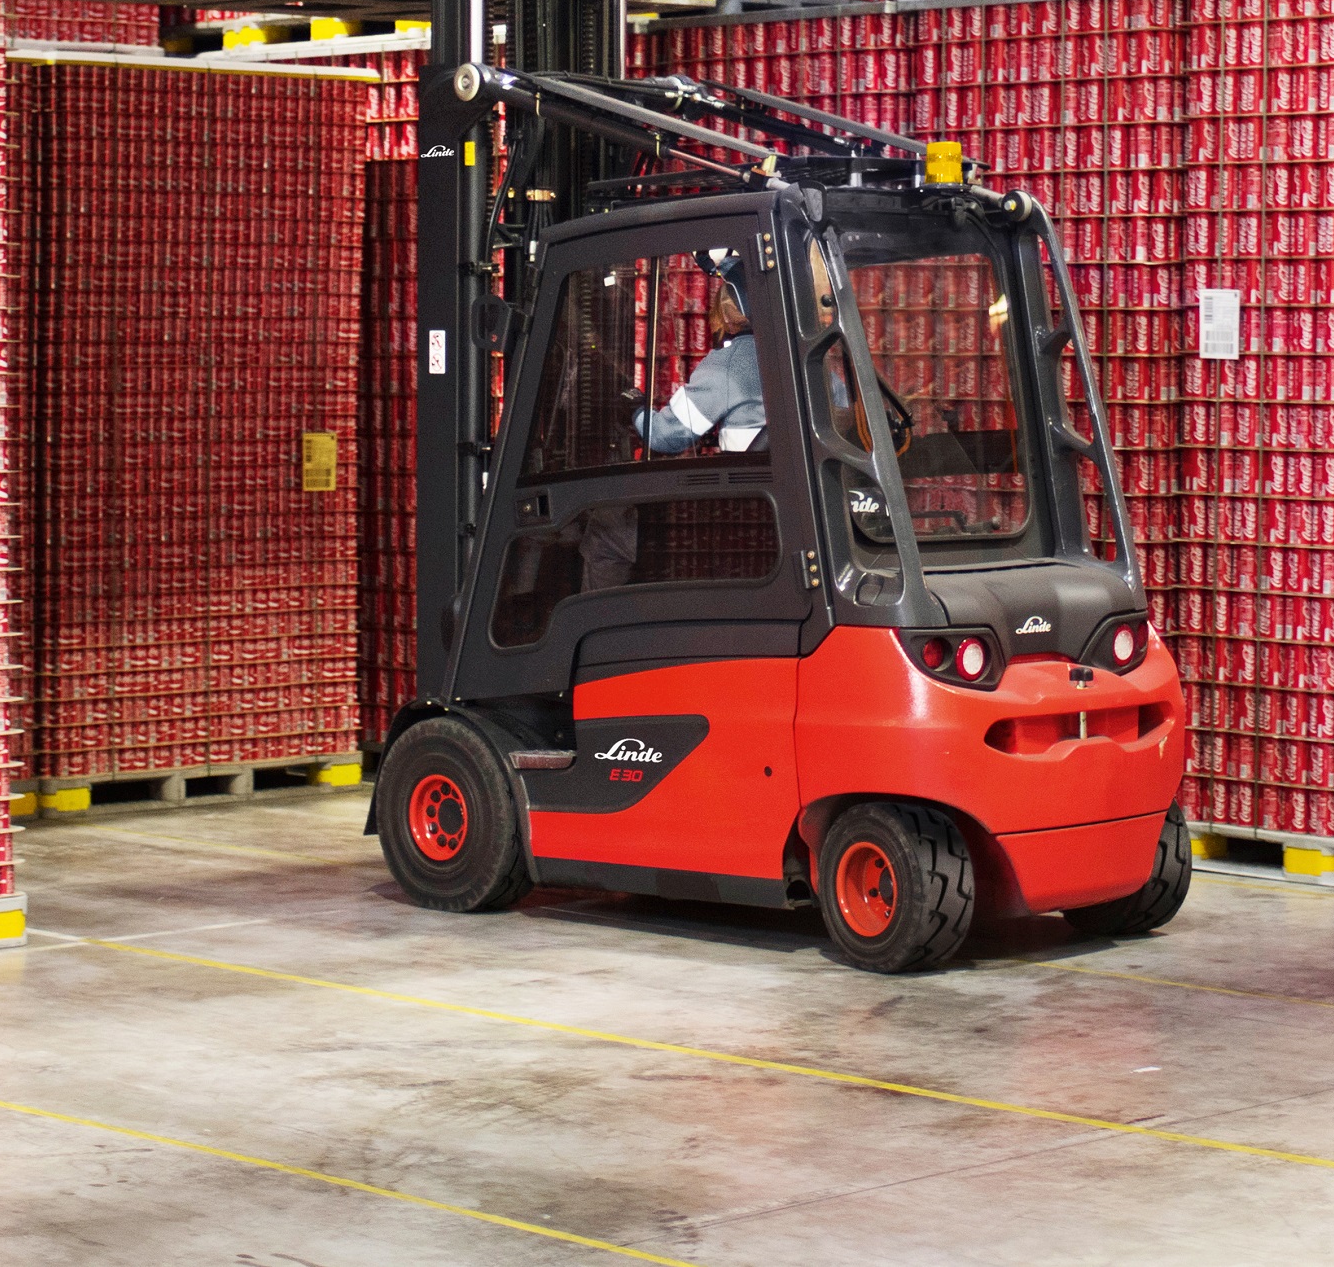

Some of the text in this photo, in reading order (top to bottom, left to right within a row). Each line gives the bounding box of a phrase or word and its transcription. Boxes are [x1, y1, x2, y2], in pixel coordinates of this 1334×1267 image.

[420, 145, 455, 158] Linde
[1015, 615, 1052, 635] Linde
[594, 738, 663, 763] Linde
